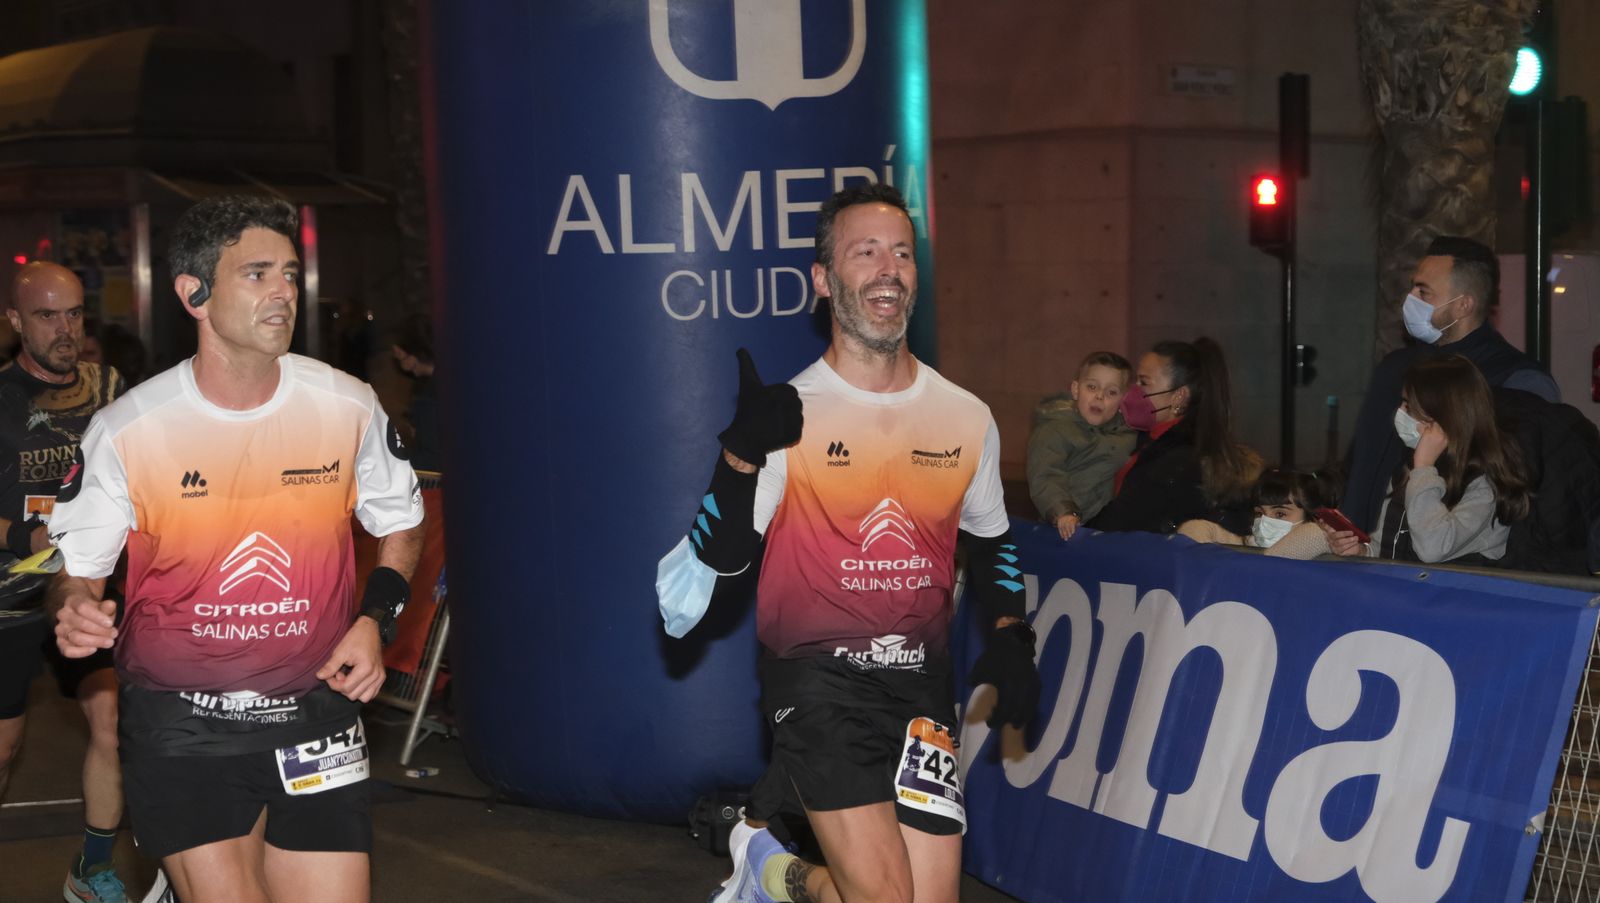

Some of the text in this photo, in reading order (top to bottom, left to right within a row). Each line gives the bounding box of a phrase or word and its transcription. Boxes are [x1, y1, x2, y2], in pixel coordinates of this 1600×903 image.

[661, 266, 820, 321] CIUD
[827, 459, 851, 468] mobel
[911, 455, 959, 470] SALINAS CAR
[281, 474, 340, 486] SALINAS CAR
[181, 489, 208, 499] mobel
[841, 575, 932, 591] SALINAS CAR
[191, 620, 308, 640] SALINAS CAR
